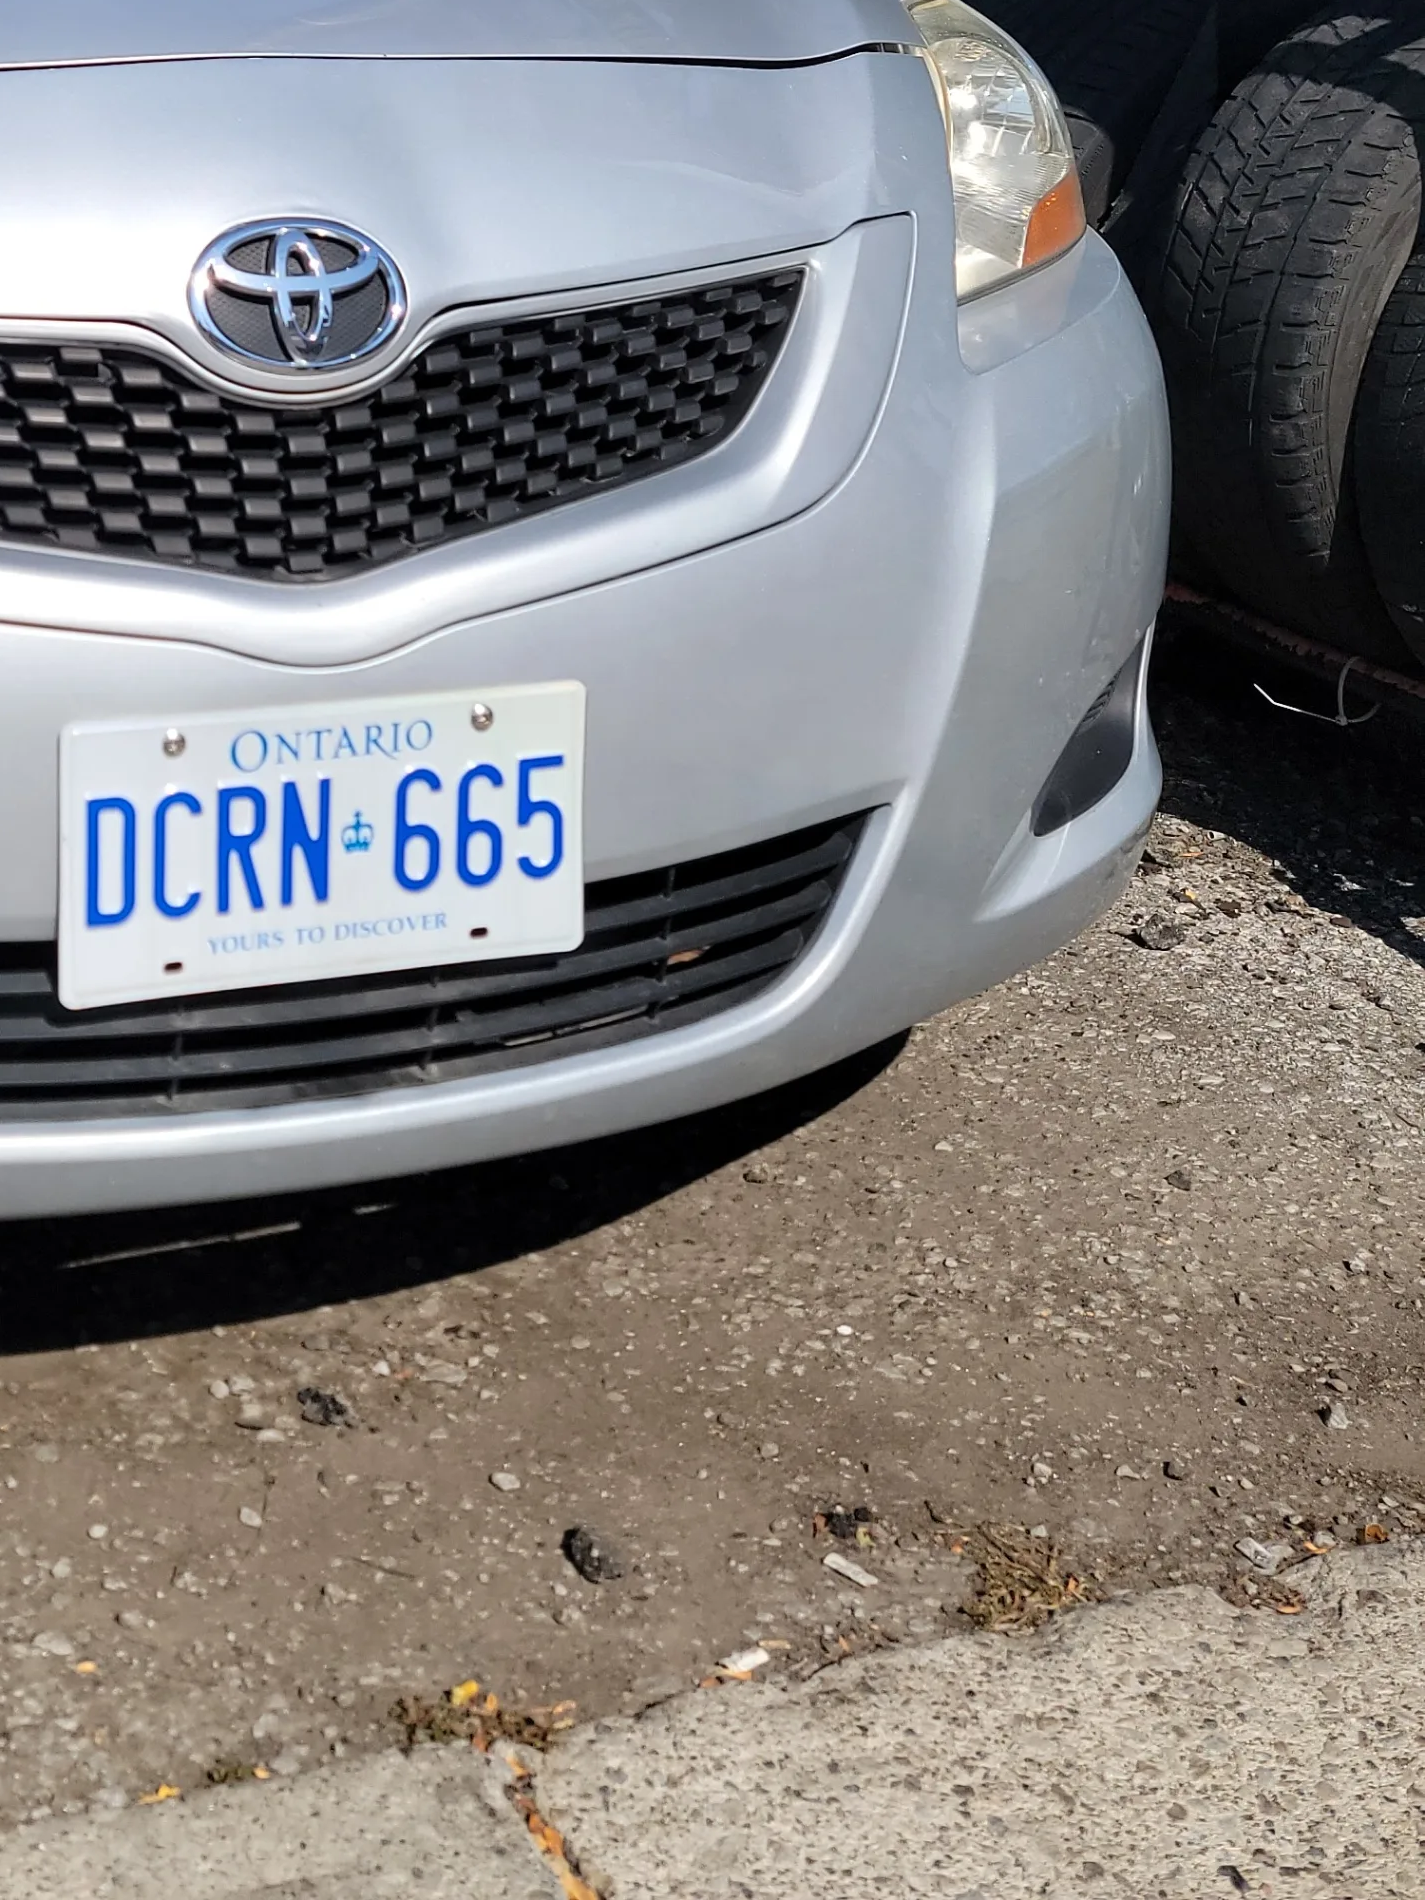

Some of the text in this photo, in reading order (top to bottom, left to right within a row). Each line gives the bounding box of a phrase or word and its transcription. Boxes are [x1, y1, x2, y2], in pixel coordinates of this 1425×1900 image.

[230, 718, 433, 774] ONTARIO
[85, 754, 565, 929] DCRN 665
[206, 911, 449, 956] YOURS TO DISCOVER
